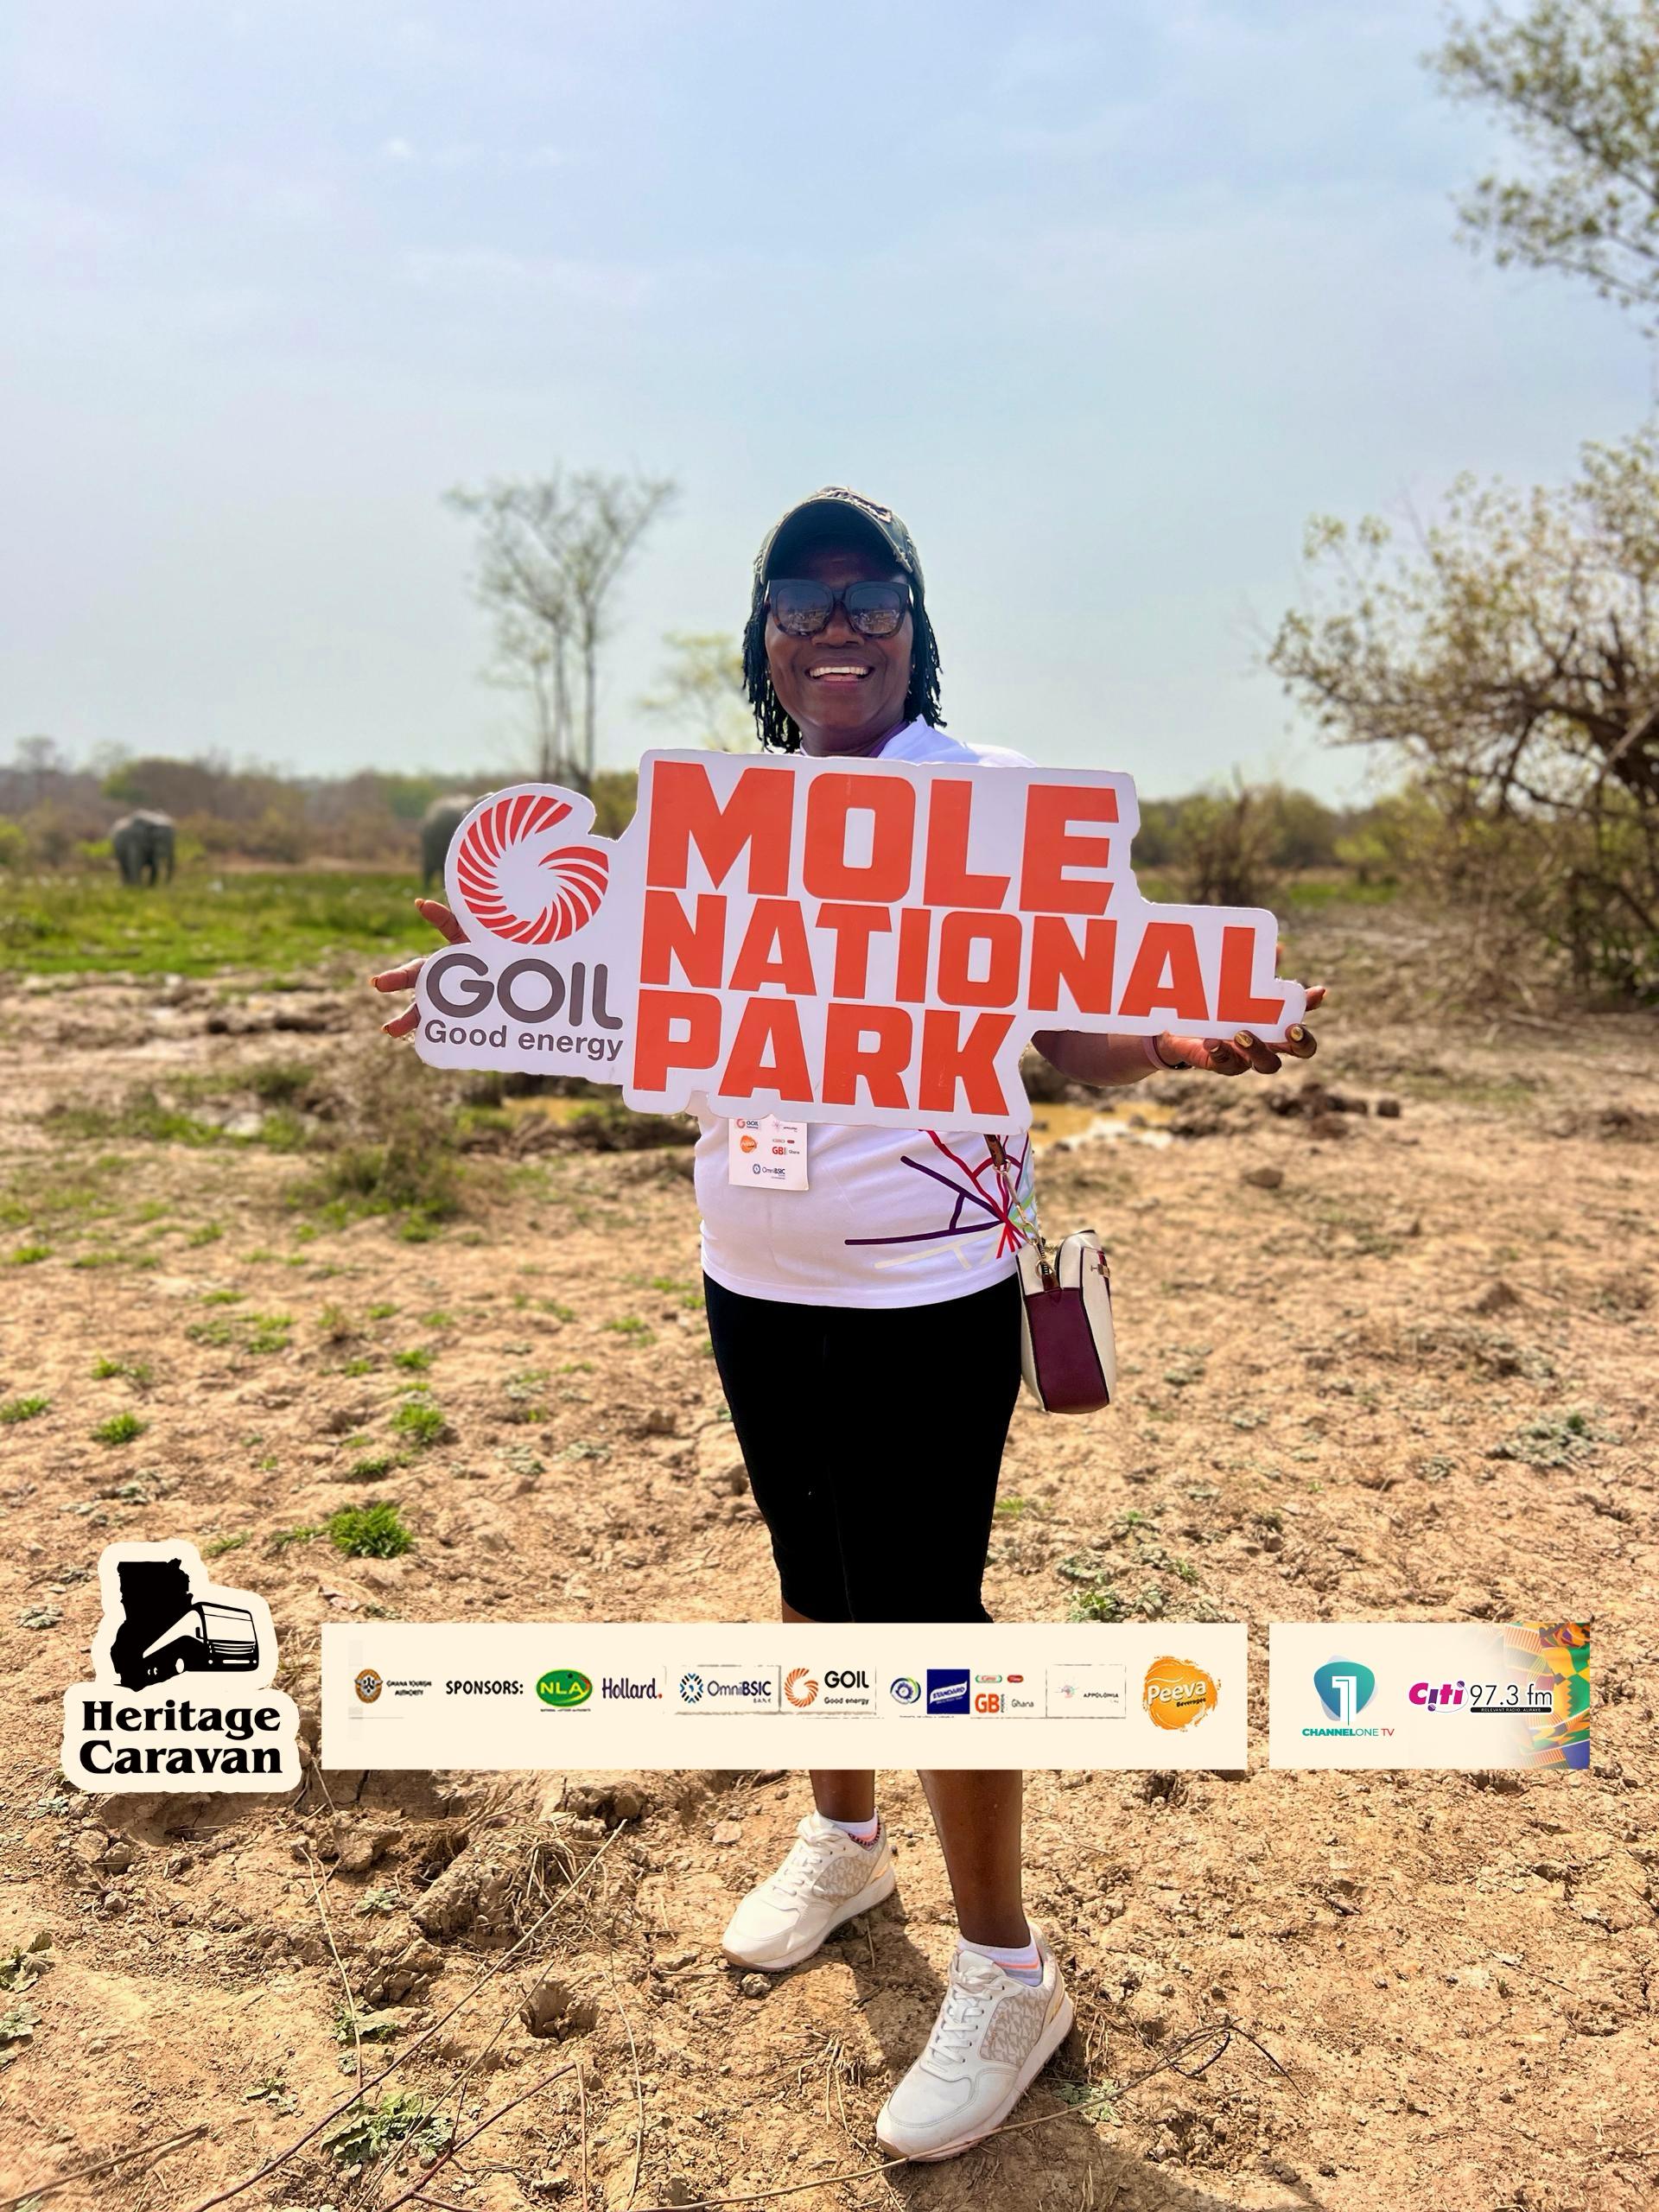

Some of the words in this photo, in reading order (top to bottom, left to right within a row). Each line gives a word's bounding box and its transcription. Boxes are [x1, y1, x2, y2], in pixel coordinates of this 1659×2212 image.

[645, 760, 1119, 915] MOLE
[426, 953, 624, 1030] GOIL
[639, 890, 1285, 1026] NATIONAL
[424, 1020, 507, 1048] Good
[518, 1032, 624, 1062] energy
[632, 989, 1015, 1116] PARK
